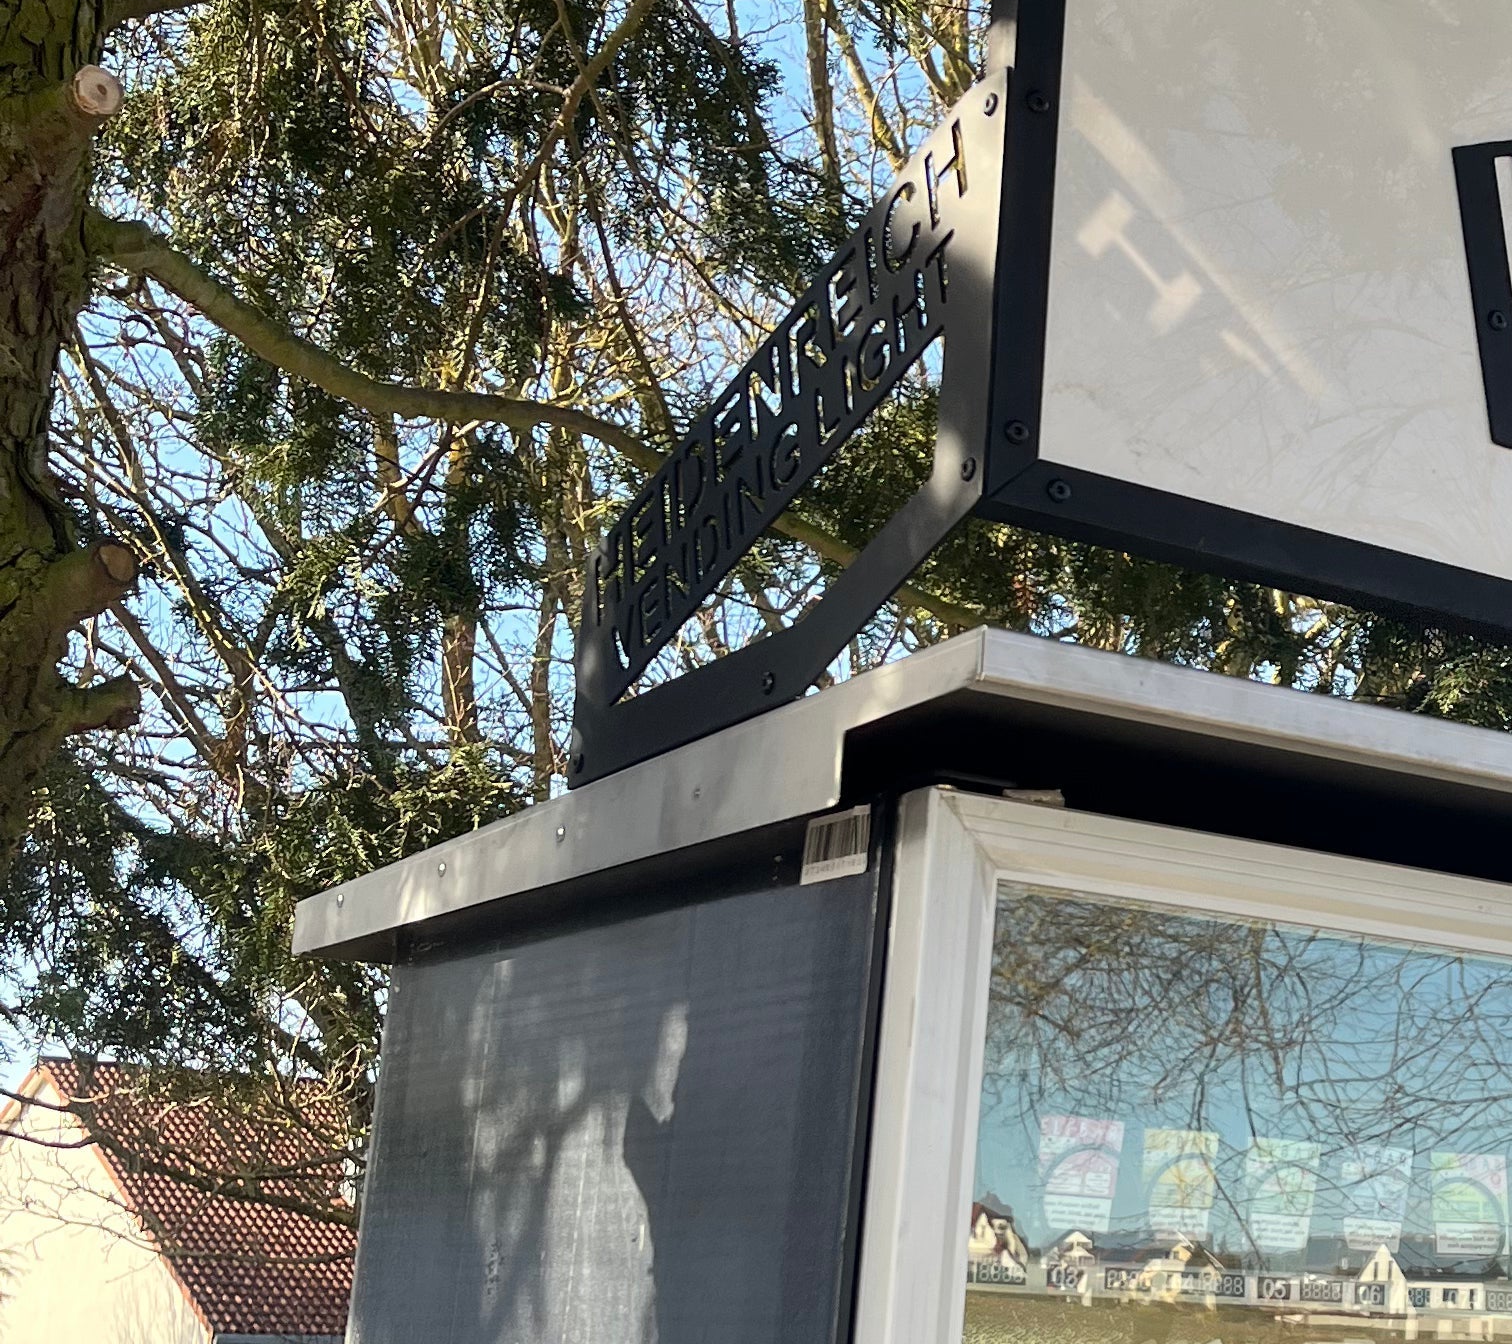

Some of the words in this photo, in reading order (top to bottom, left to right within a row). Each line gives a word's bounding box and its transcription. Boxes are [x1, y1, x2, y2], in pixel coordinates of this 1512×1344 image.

[596, 117, 968, 625] HEIDENREICH
[1261, 1278, 1288, 1299] 05
[1360, 1283, 1381, 1304] 06
